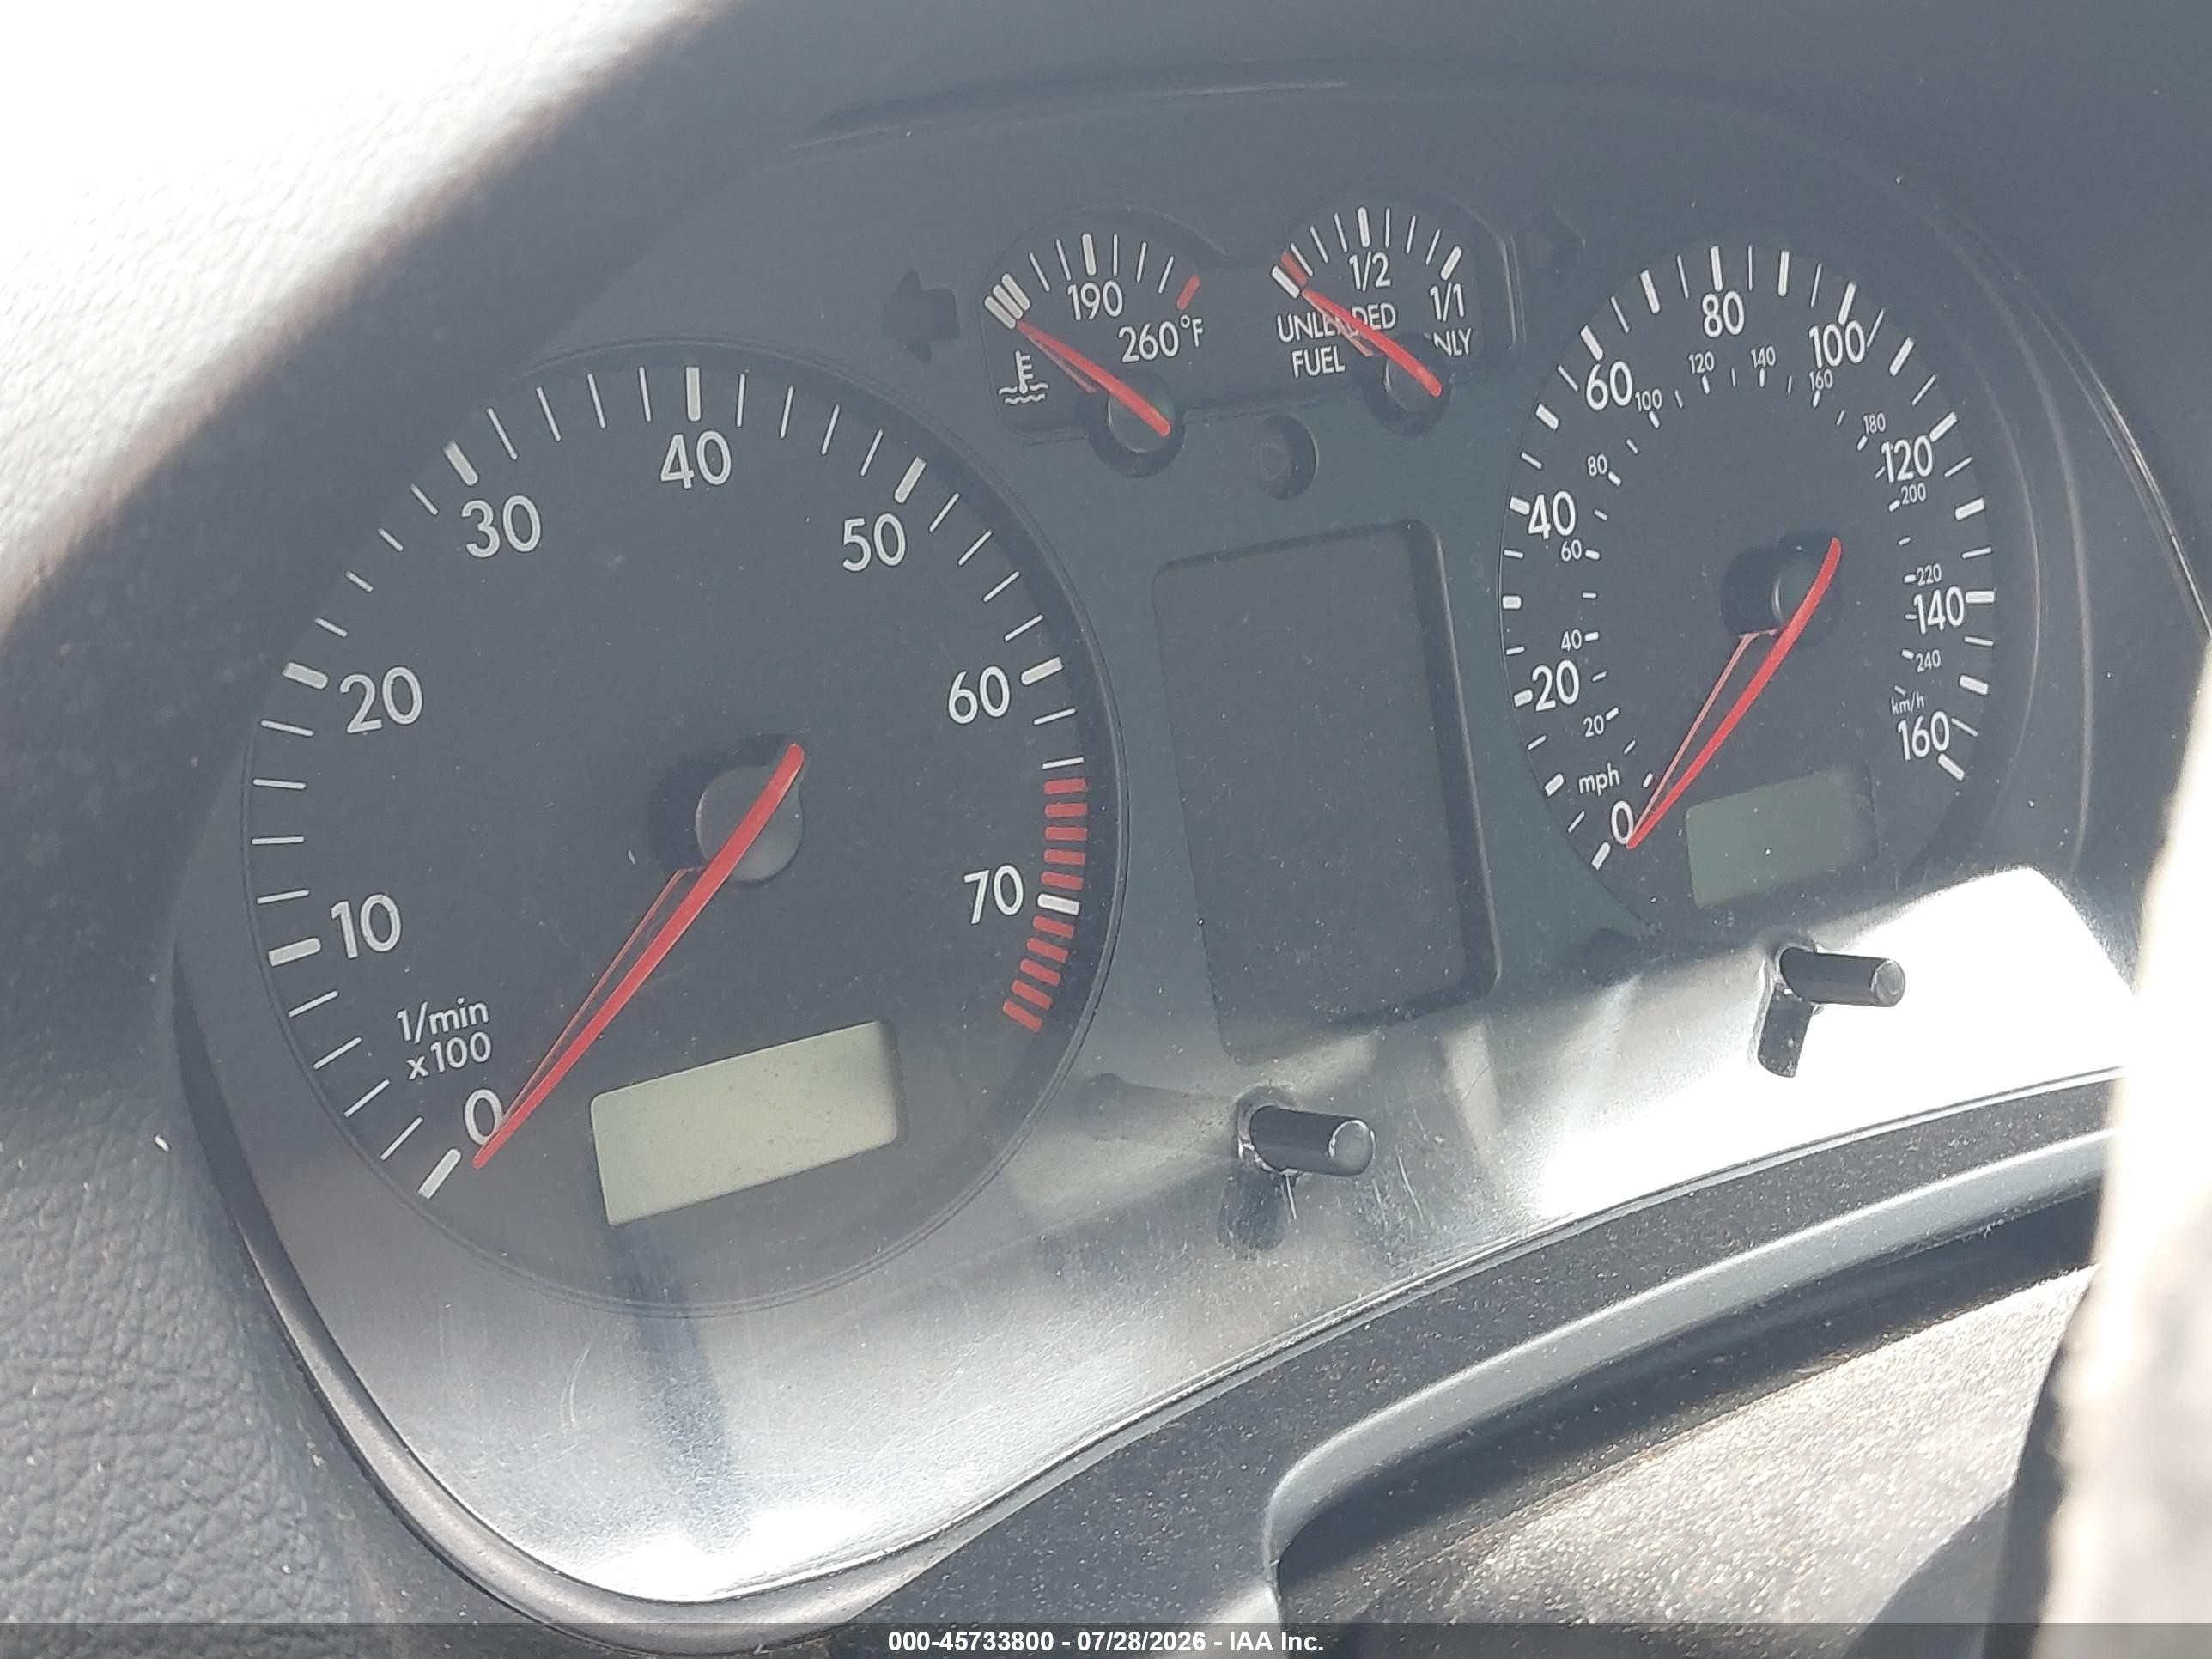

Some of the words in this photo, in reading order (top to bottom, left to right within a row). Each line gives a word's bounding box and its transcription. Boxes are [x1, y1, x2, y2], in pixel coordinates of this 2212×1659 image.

[1349, 252, 1390, 291] 1/2
[1066, 281, 1124, 320] 190
[1430, 283, 1465, 322] 1/1
[1702, 291, 1745, 338] 80
[1291, 345, 1346, 379] FUEL
[1425, 327, 1472, 357] NLY
[1689, 349, 1715, 374] 120
[1751, 346, 1777, 368] 140
[1809, 320, 1865, 368] 100
[1585, 359, 1632, 410] 60
[1635, 387, 1663, 412] 100
[1808, 369, 1833, 391] 160
[1863, 412, 1887, 434] 180
[659, 429, 733, 489] 40
[1587, 454, 1608, 477] 80
[1881, 434, 1934, 483] 120
[1528, 490, 1577, 538] 40
[1900, 482, 1927, 505] 200
[460, 495, 543, 558] 30
[842, 514, 907, 572] 50
[1559, 539, 1583, 562] 60
[1916, 563, 1942, 586] 220
[1913, 586, 1965, 634] 140
[1560, 629, 1583, 651] 40
[1915, 649, 1942, 672] 240
[338, 666, 424, 733] 20
[947, 666, 1012, 725] 60
[1531, 659, 1580, 712] 20
[1891, 692, 1926, 716] km/h
[1583, 715, 1604, 739] 20
[1898, 711, 1950, 762] 160
[1578, 763, 1621, 795] mph
[1610, 800, 1633, 845] 0
[963, 864, 1024, 925] 70
[330, 894, 402, 959] 10
[397, 997, 489, 1045] 1/min
[406, 1031, 492, 1080] x100
[465, 1089, 504, 1146] 0
